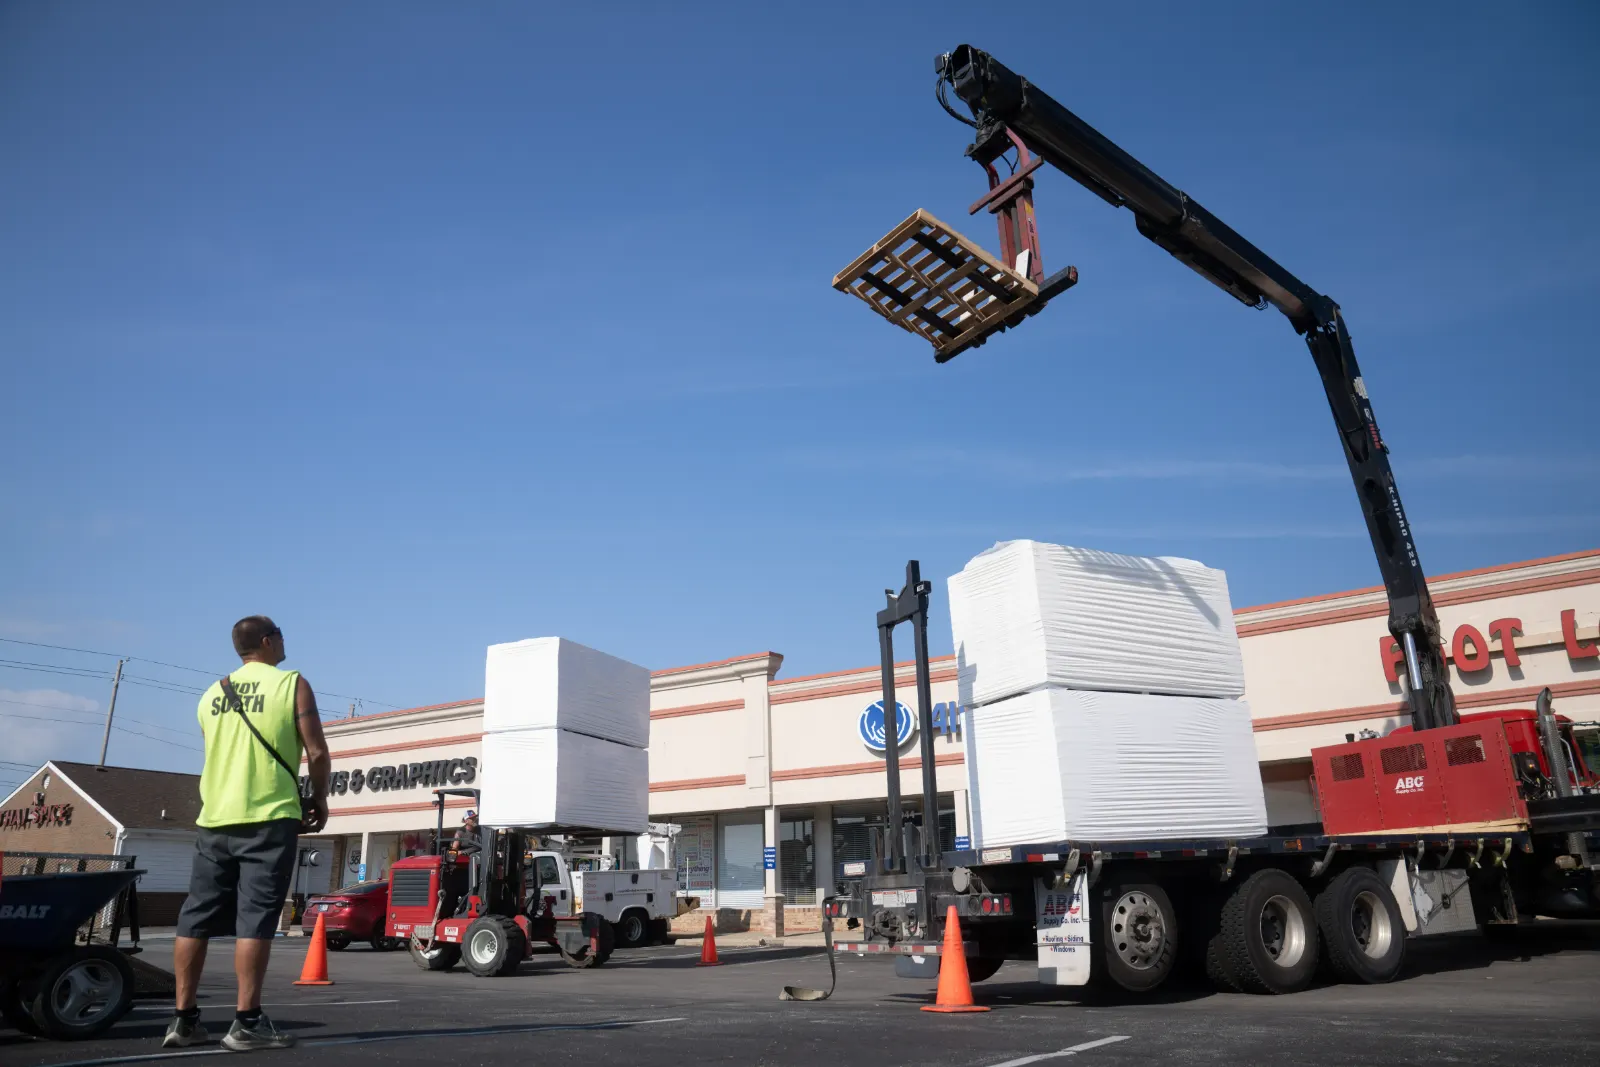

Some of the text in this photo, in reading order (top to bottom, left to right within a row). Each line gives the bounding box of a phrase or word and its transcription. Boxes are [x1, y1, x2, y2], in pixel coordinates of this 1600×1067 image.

[1379, 617, 1523, 683] FOT
[211, 694, 266, 716] SOTH
[366, 756, 478, 793] GRAPHICS
[1395, 776, 1425, 790] ABC
[0, 904, 51, 919] BALT
[1041, 893, 1082, 916] ABC
